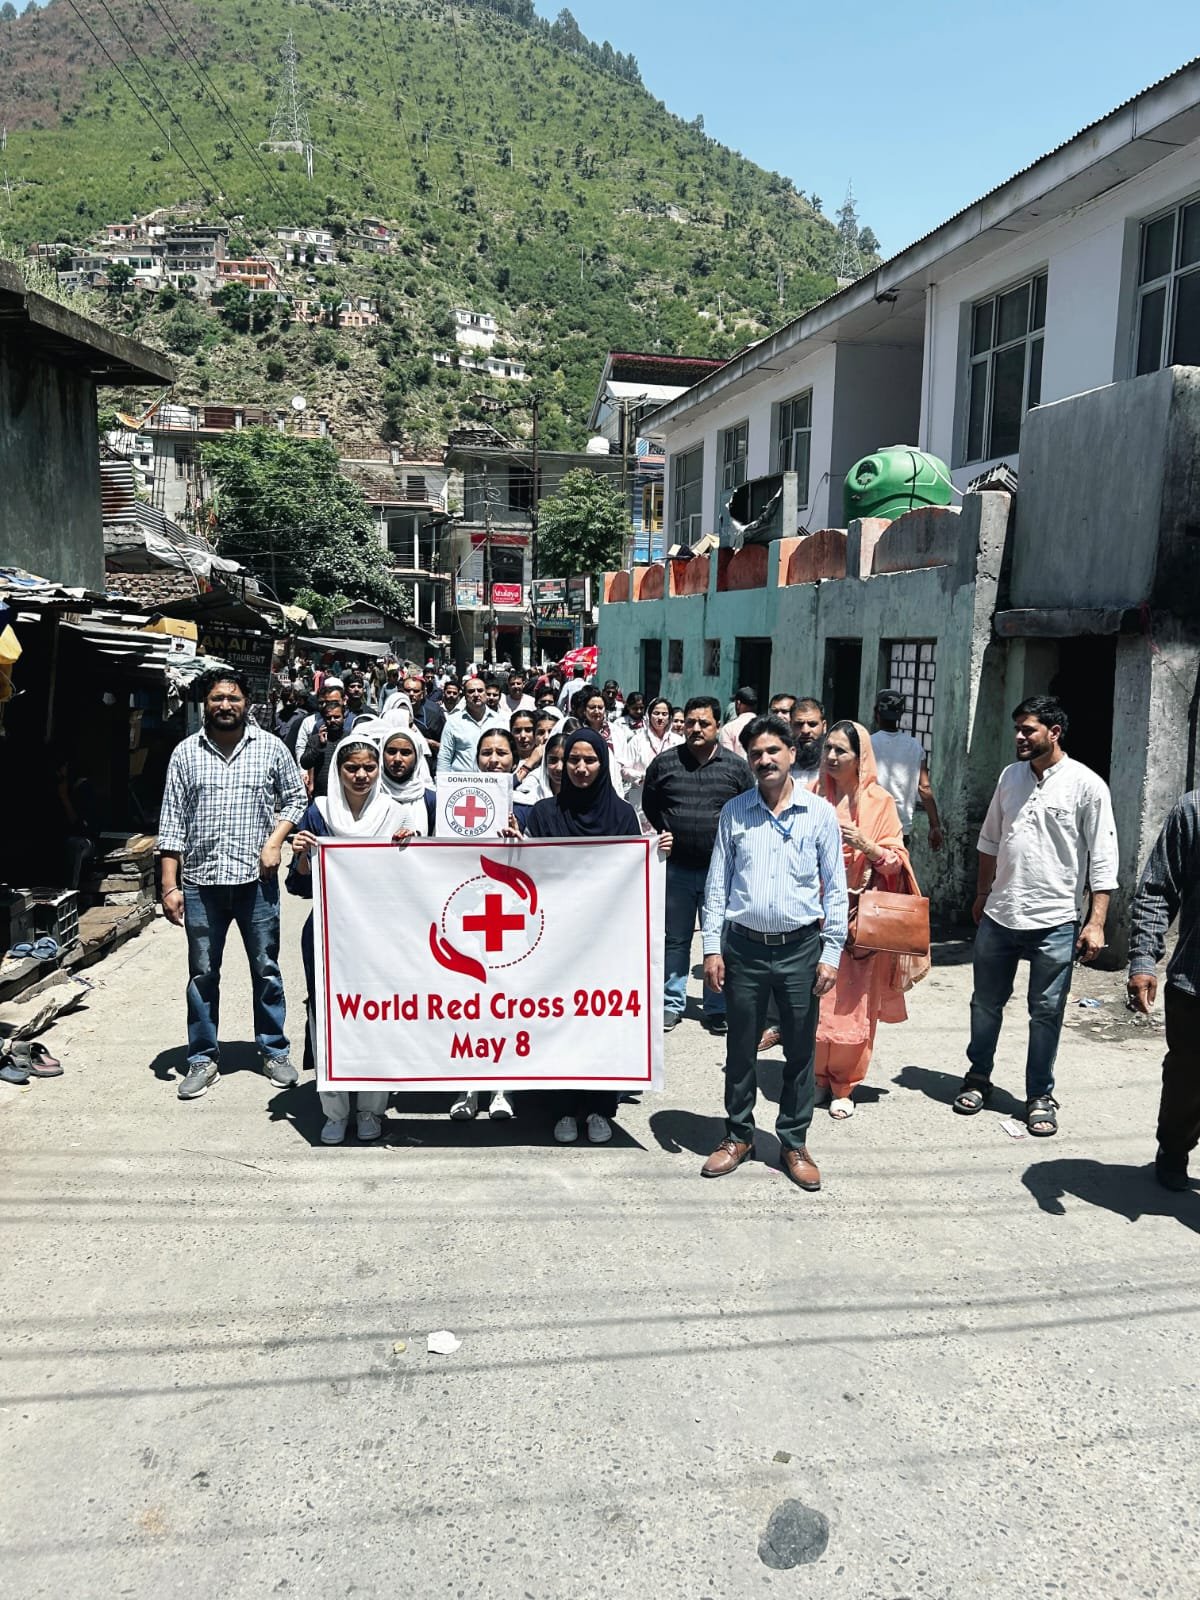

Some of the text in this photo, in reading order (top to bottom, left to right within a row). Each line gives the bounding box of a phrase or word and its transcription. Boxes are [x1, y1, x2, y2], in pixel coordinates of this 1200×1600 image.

[447, 776, 483, 784] DONATION
[447, 788, 494, 810] SERVE HUMANITY
[450, 820, 489, 836] RED CROSS
[336, 989, 641, 1021] World Red Cross 2024
[450, 1030, 530, 1063] May 8
